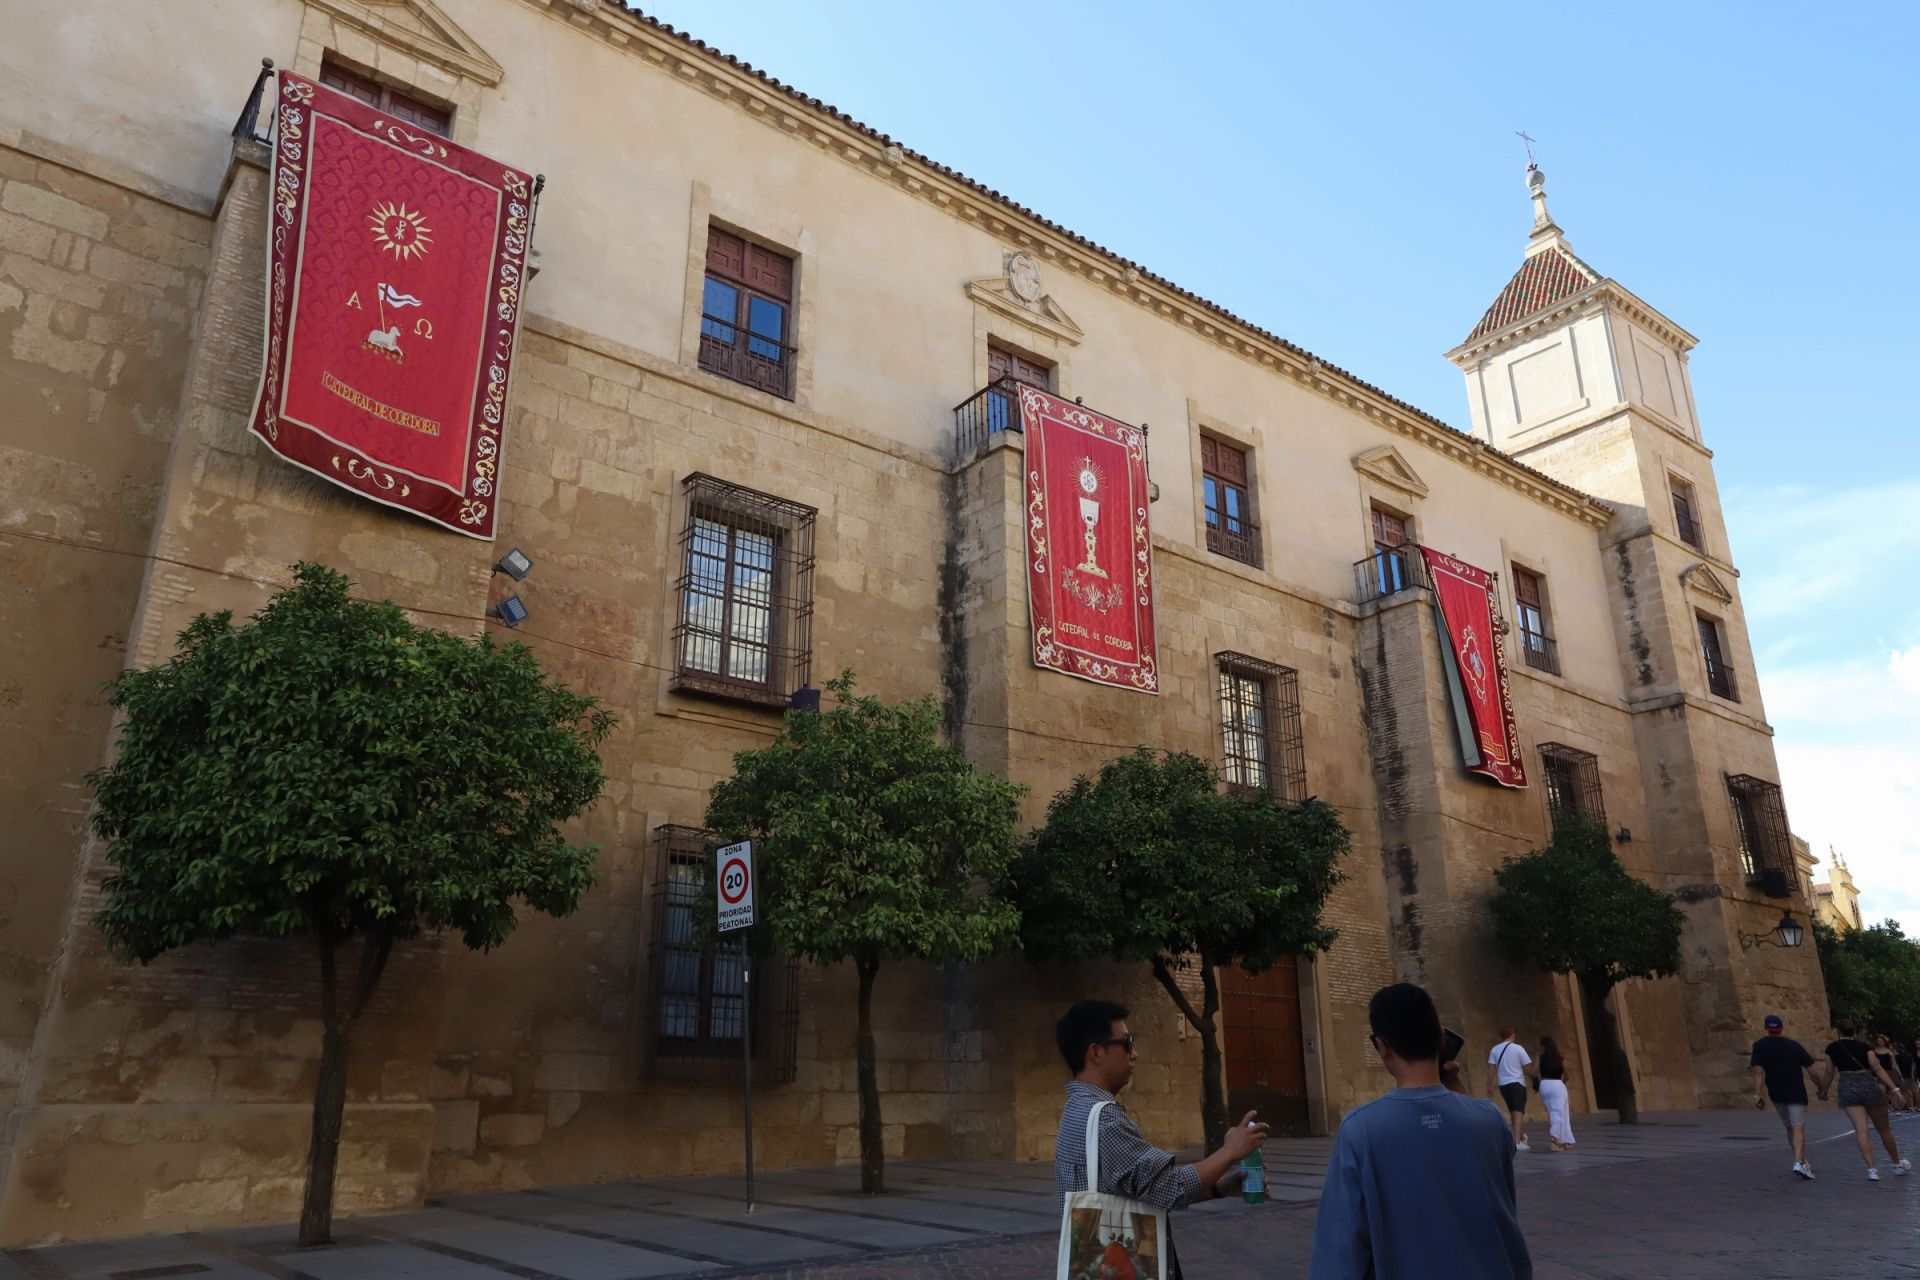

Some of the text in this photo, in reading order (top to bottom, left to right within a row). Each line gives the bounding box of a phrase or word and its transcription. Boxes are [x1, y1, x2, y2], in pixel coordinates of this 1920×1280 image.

[414, 318, 433, 340] Ω
[325, 374, 438, 435] CATEDRAL DE CORDOBA
[1058, 620, 1089, 639] CATEDRAL
[724, 844, 743, 856] ZONA
[726, 872, 743, 890] 20
[719, 905, 752, 919] PRIORIDAD
[718, 916, 753, 930] PEATONAL
